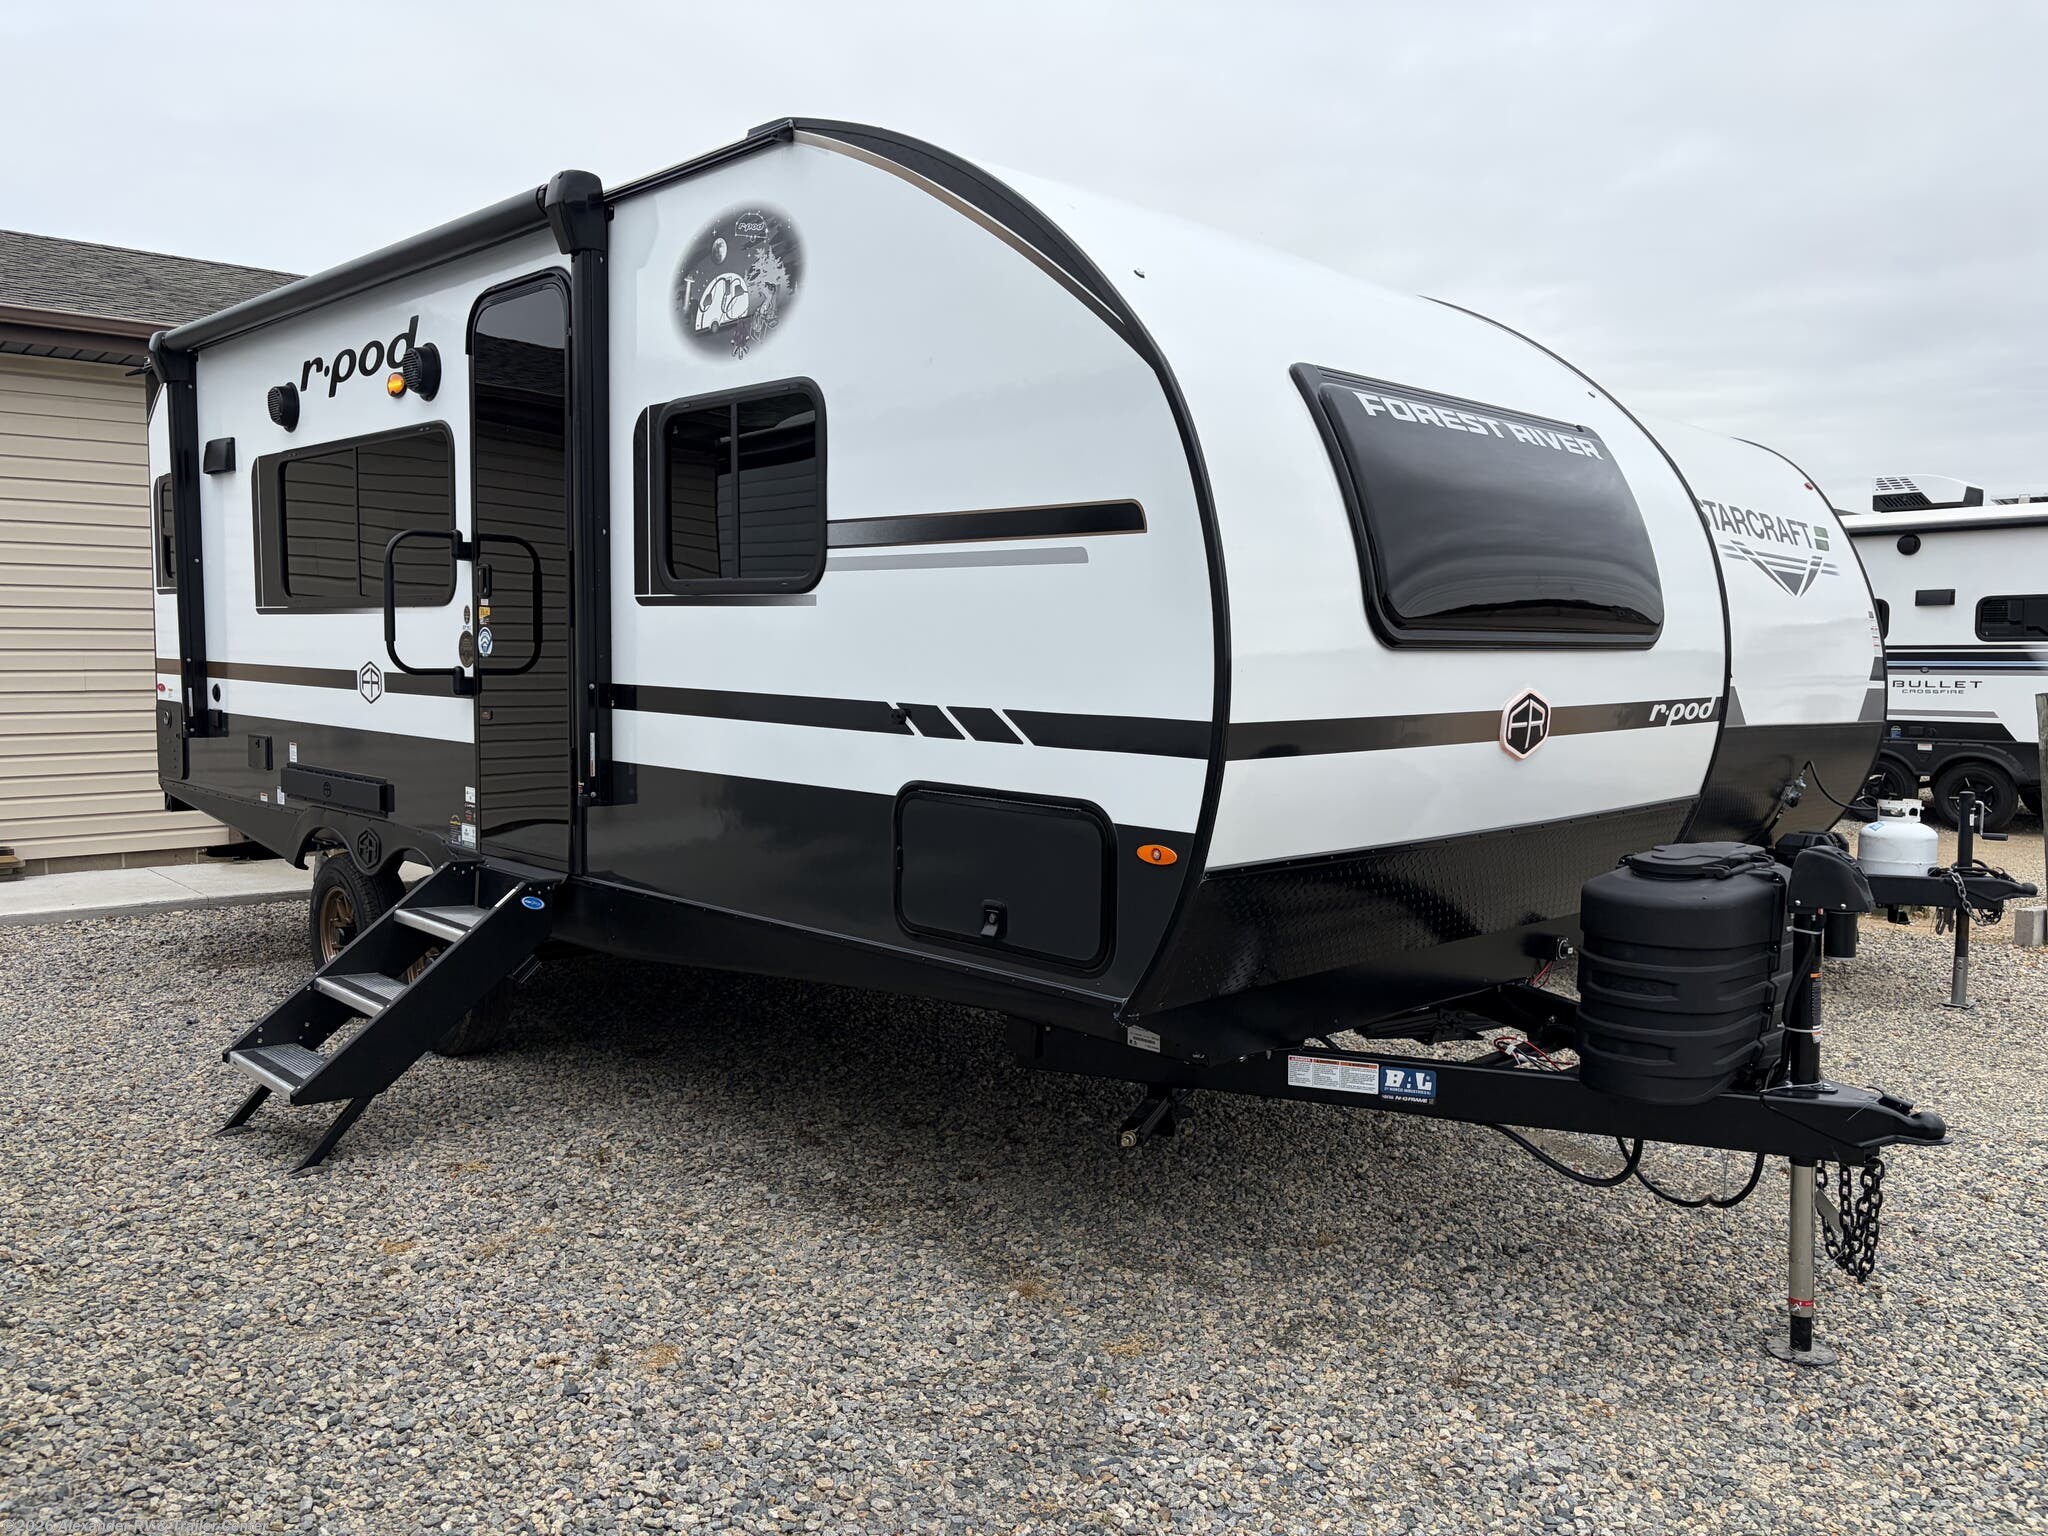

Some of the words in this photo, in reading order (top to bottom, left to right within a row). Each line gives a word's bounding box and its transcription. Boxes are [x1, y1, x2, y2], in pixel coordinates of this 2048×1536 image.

[1353, 390, 1504, 438] FOREST
[1503, 422, 1604, 460] RIVER
[1892, 680, 1983, 689] BULLET
